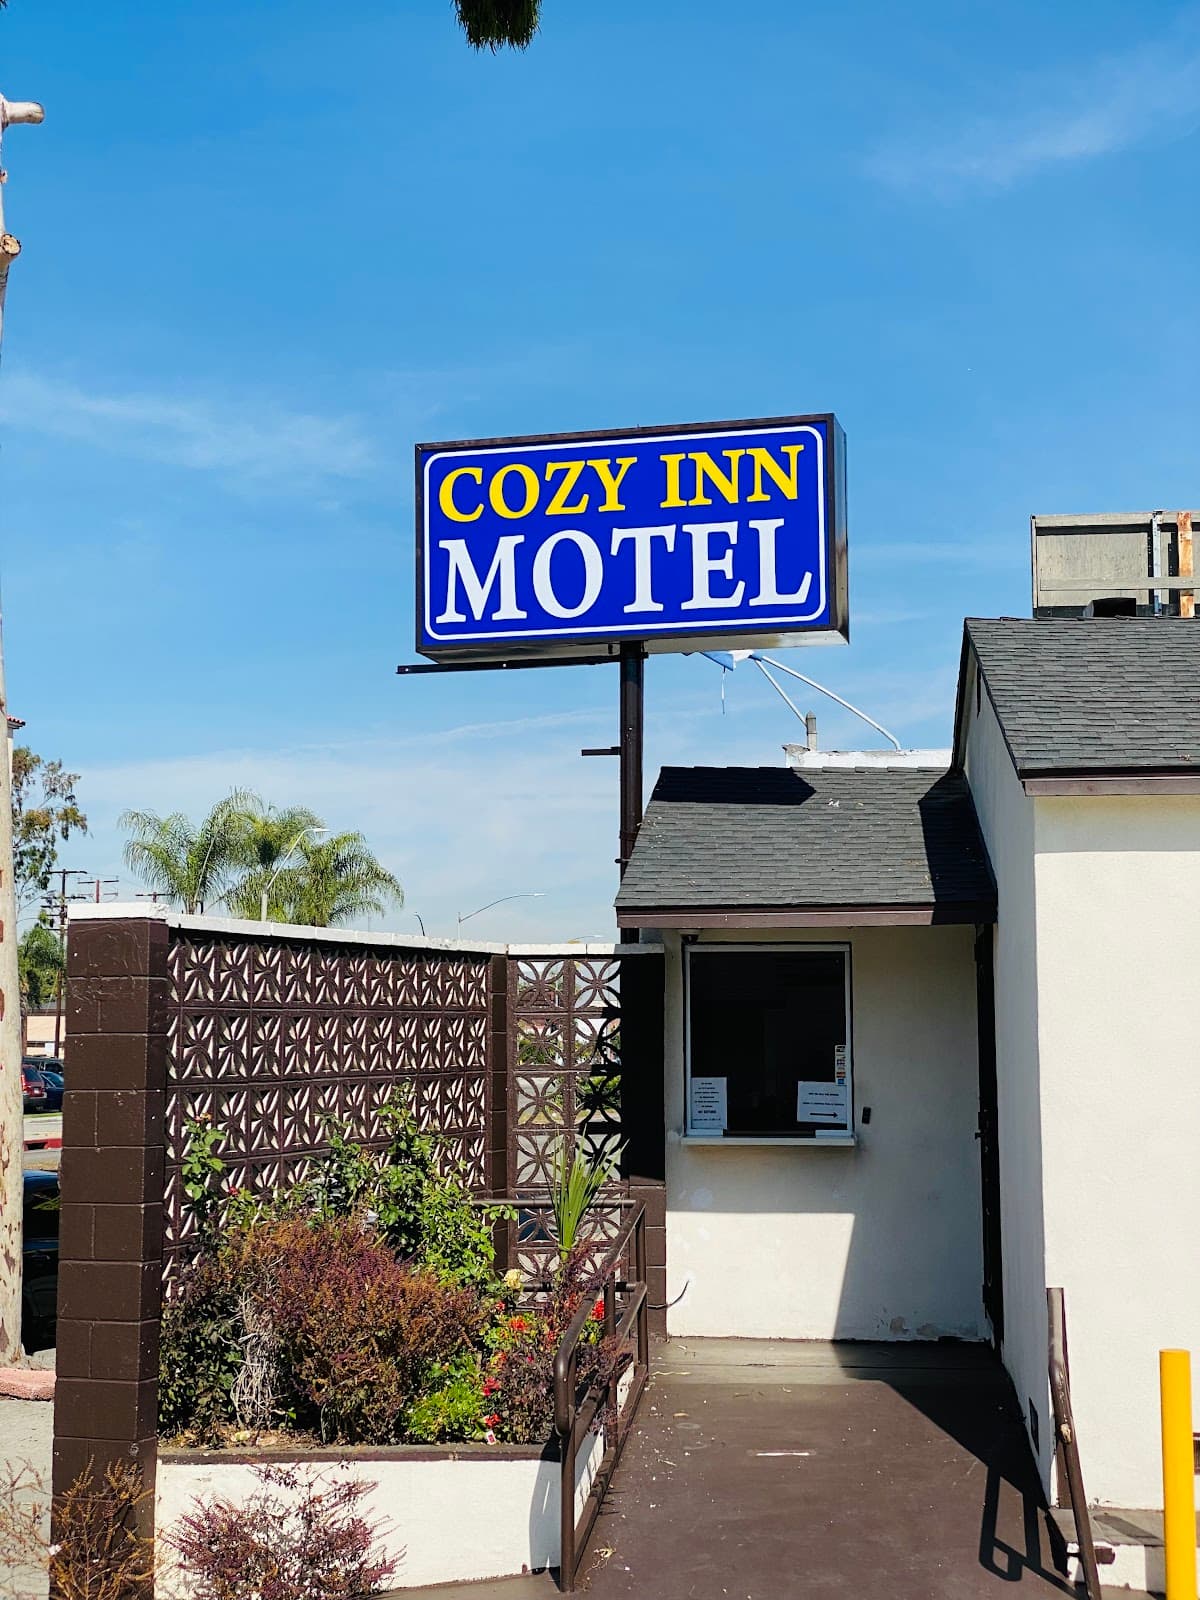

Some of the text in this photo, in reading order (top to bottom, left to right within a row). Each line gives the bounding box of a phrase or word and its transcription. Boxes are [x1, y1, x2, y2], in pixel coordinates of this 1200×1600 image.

[438, 444, 804, 523] COZY INN
[435, 518, 813, 624] MOTEL
